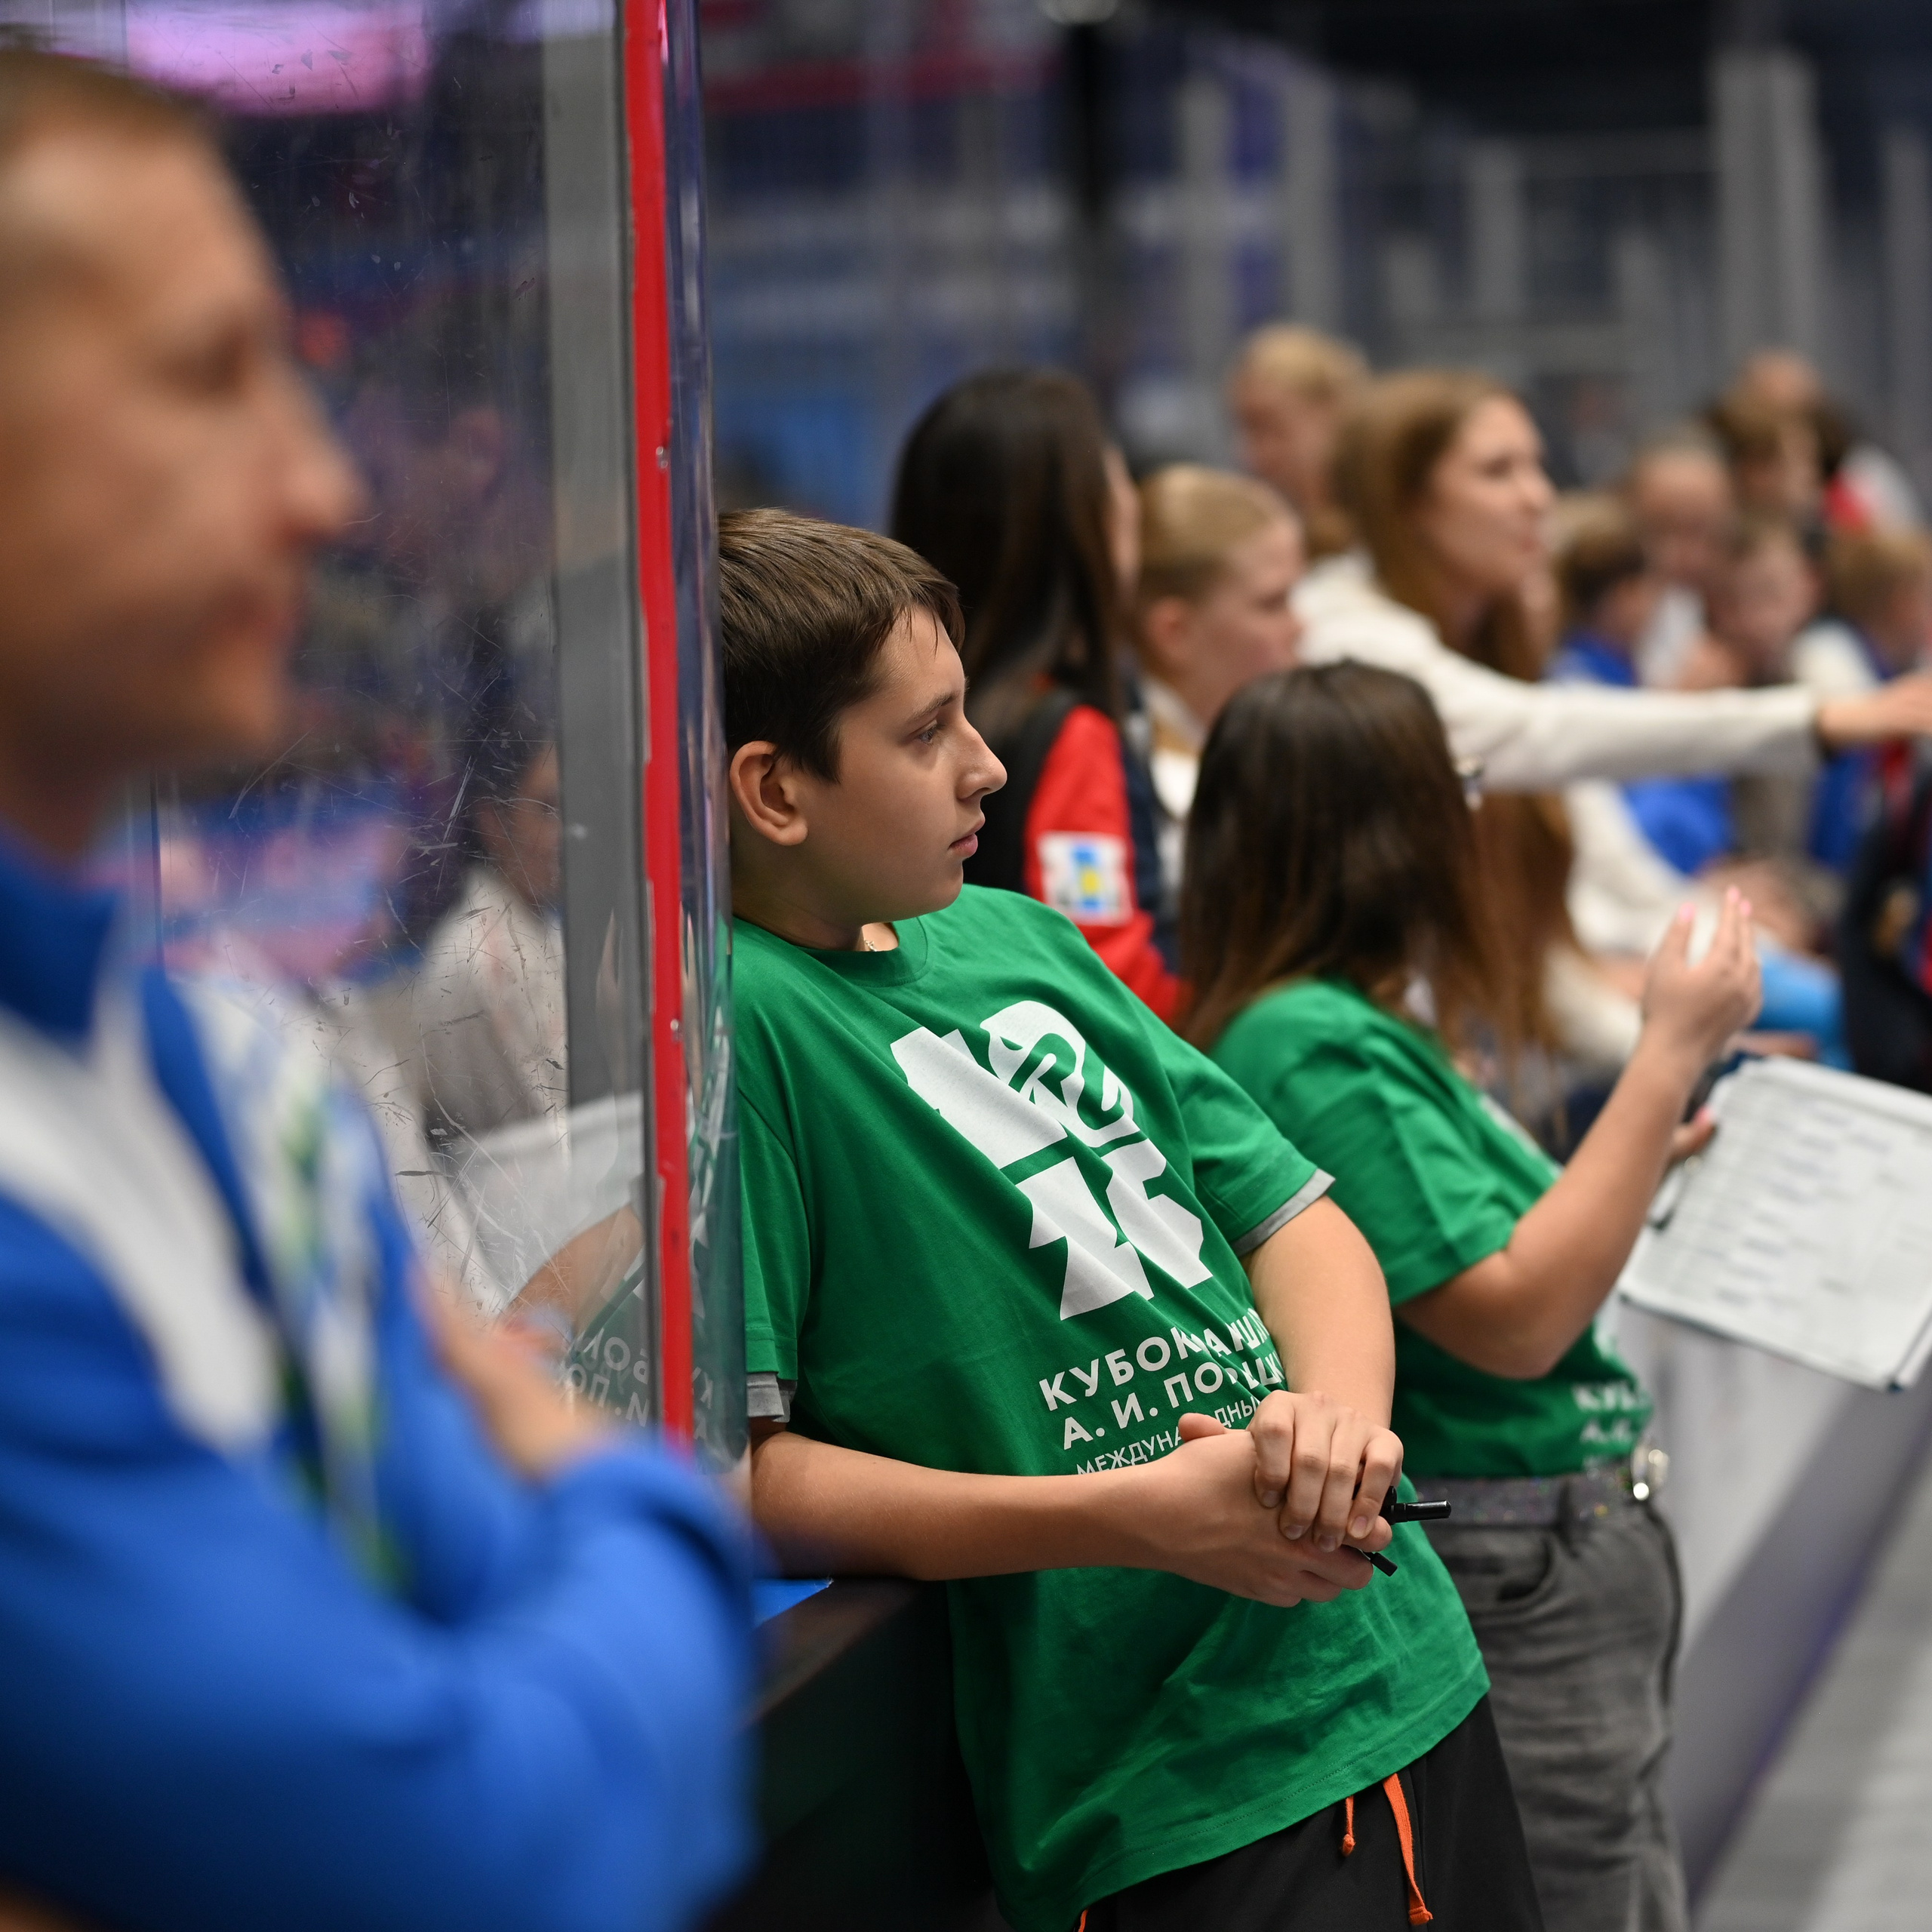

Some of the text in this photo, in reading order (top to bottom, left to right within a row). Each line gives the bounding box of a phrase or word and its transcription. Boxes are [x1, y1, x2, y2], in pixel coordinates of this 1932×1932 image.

[1038, 1326, 1202, 1411] КУБОК
[1064, 1417, 1105, 1450] А.
[1111, 1392, 1158, 1429] И.
